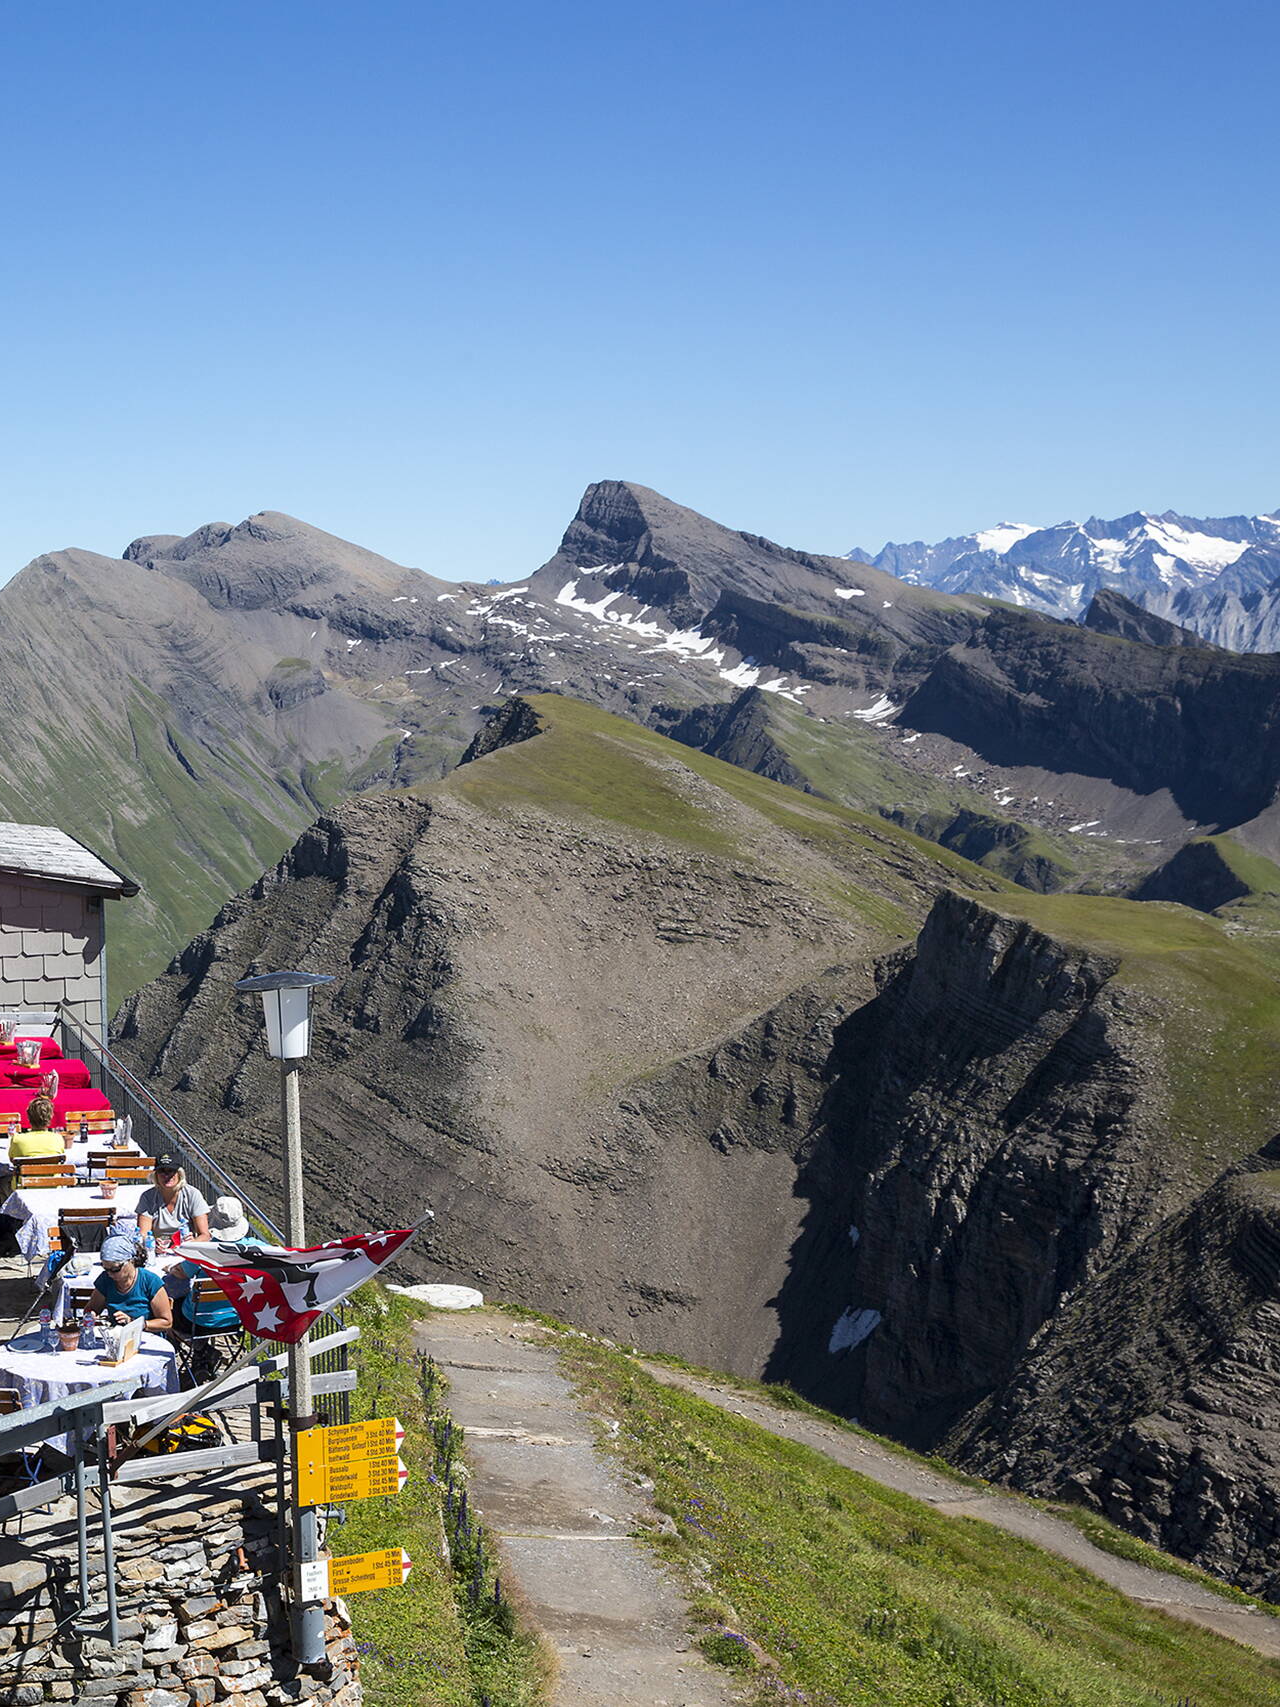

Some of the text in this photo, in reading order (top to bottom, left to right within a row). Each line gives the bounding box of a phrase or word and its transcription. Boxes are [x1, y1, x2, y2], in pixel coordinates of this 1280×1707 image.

[330, 1473, 358, 1482] Grindelwald
[330, 1490, 358, 1500] Grindelwald
[381, 1486, 388, 1494] 30
[332, 1557, 364, 1568] Gassenboden
[384, 1560, 390, 1568] 45
[333, 1586, 348, 1594] Axalp
